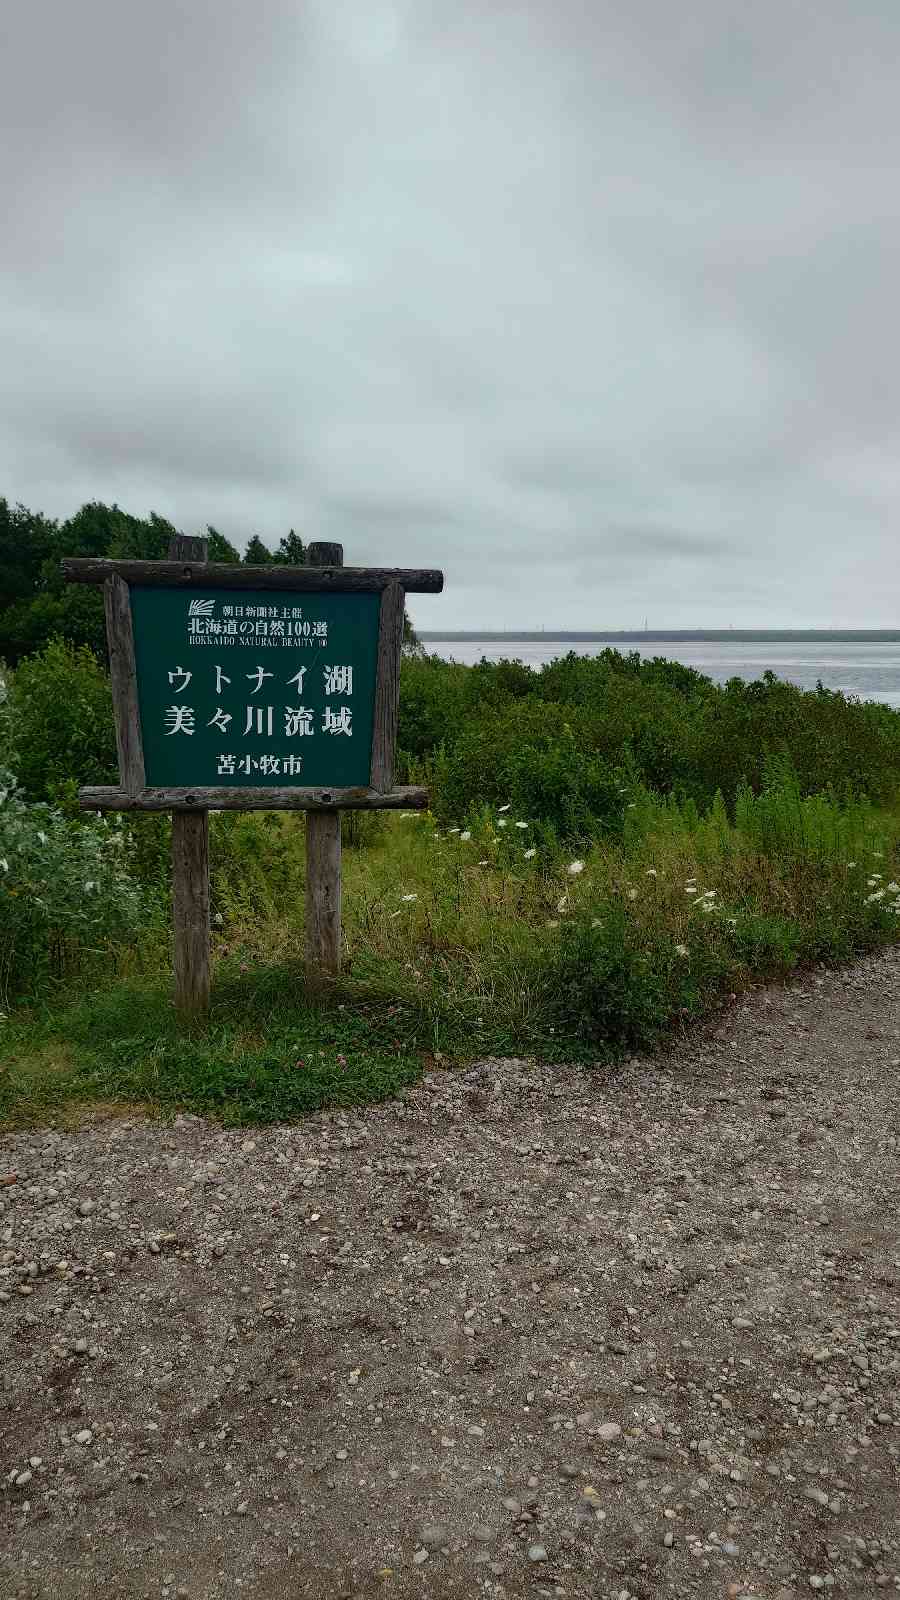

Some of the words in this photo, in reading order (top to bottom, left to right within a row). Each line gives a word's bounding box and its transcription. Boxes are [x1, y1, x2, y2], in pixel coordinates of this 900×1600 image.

[222, 605, 303, 619] 朝日新聞社主催
[187, 618, 328, 637] 北海道の自然100選
[189, 635, 235, 646] HOKKAIDO
[239, 636, 278, 647] NATURAL
[282, 637, 315, 648] BEAUTY
[168, 665, 353, 696] ウトナイ湖
[163, 705, 353, 737] 美々川流域
[216, 754, 302, 776] 苫小牧市
